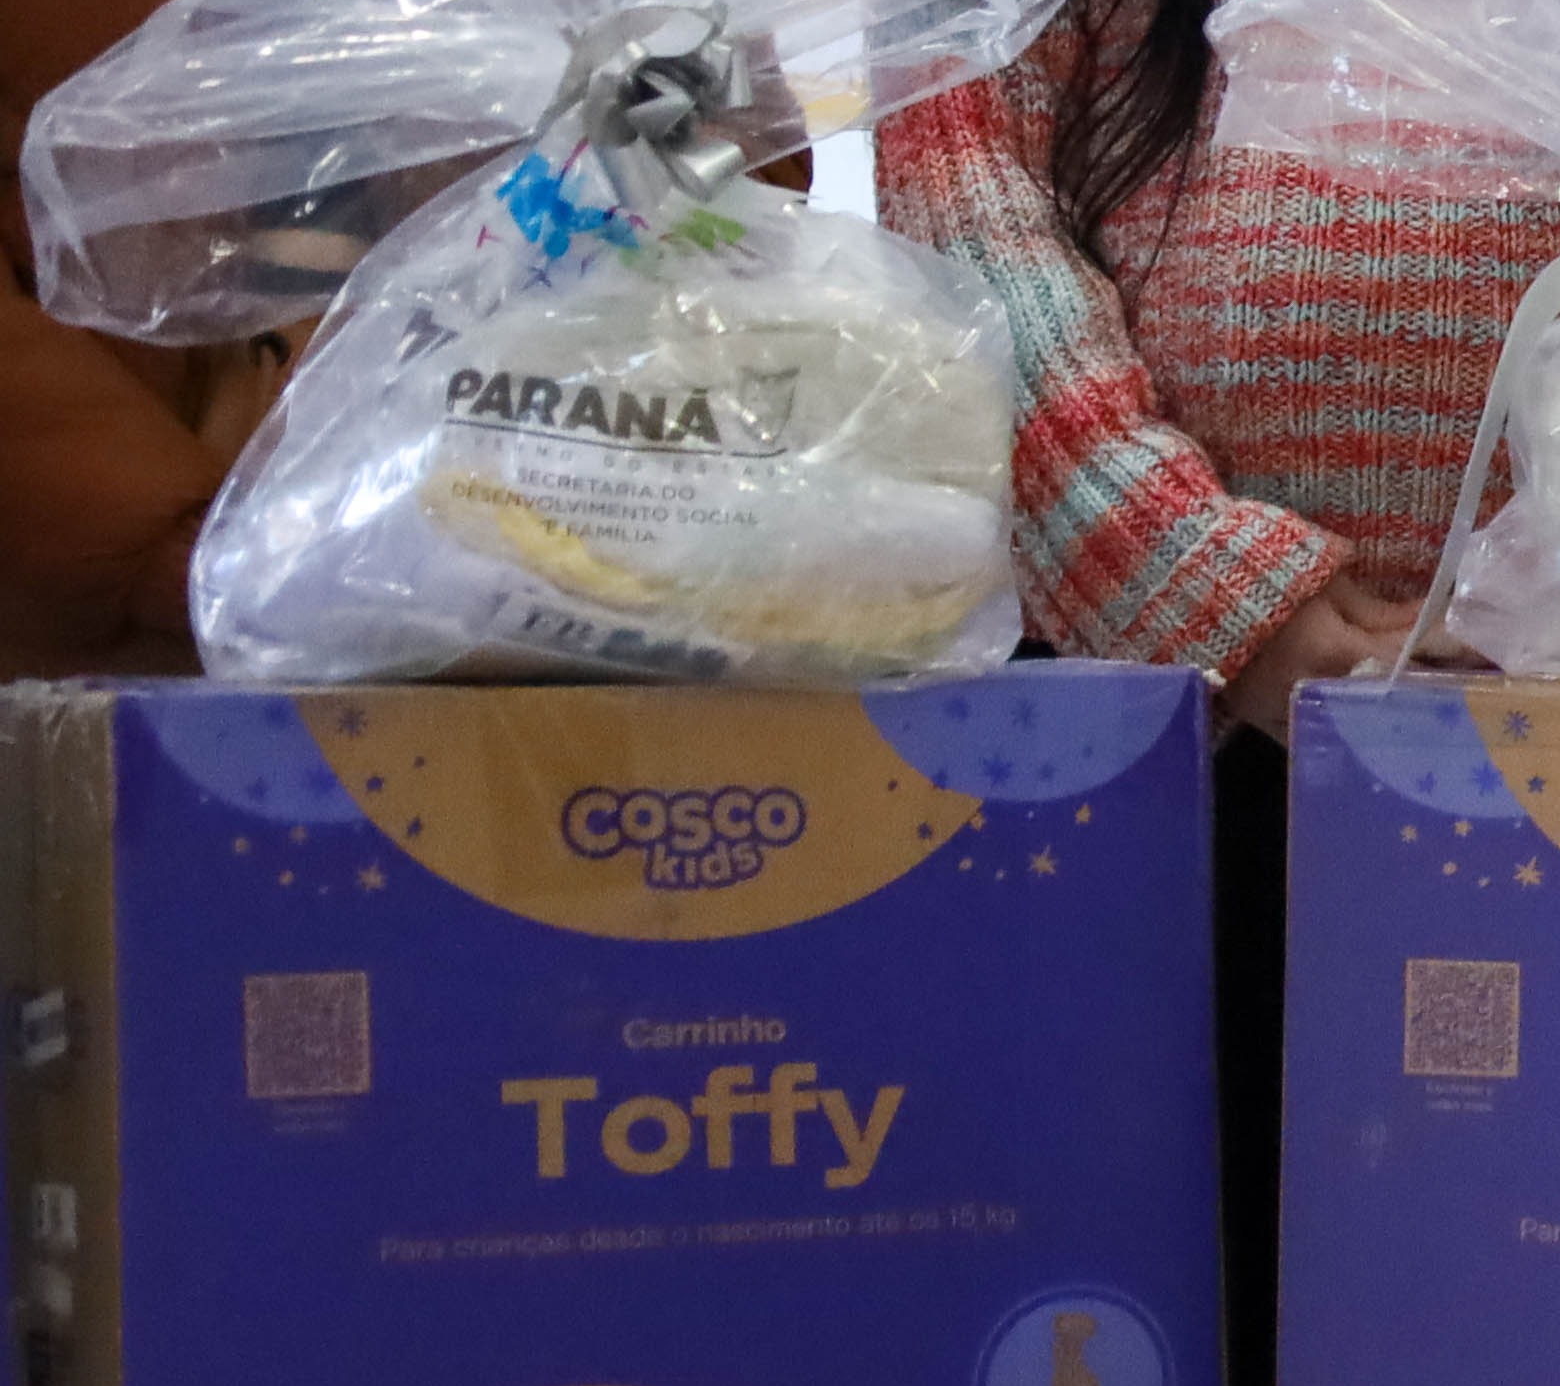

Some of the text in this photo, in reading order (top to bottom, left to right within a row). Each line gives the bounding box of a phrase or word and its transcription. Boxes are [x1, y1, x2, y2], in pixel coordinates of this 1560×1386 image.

[446, 369, 722, 444] PARANÁ
[452, 481, 759, 526] DESENVOLVIMENTO SOCIAL
[517, 468, 658, 500] SECRETARIA
[662, 485, 695, 502] DO
[567, 522, 657, 544] FAMÍLIA
[645, 838, 764, 890] kids
[622, 1016, 788, 1050] Carrinho
[501, 1062, 905, 1190] Toffy
